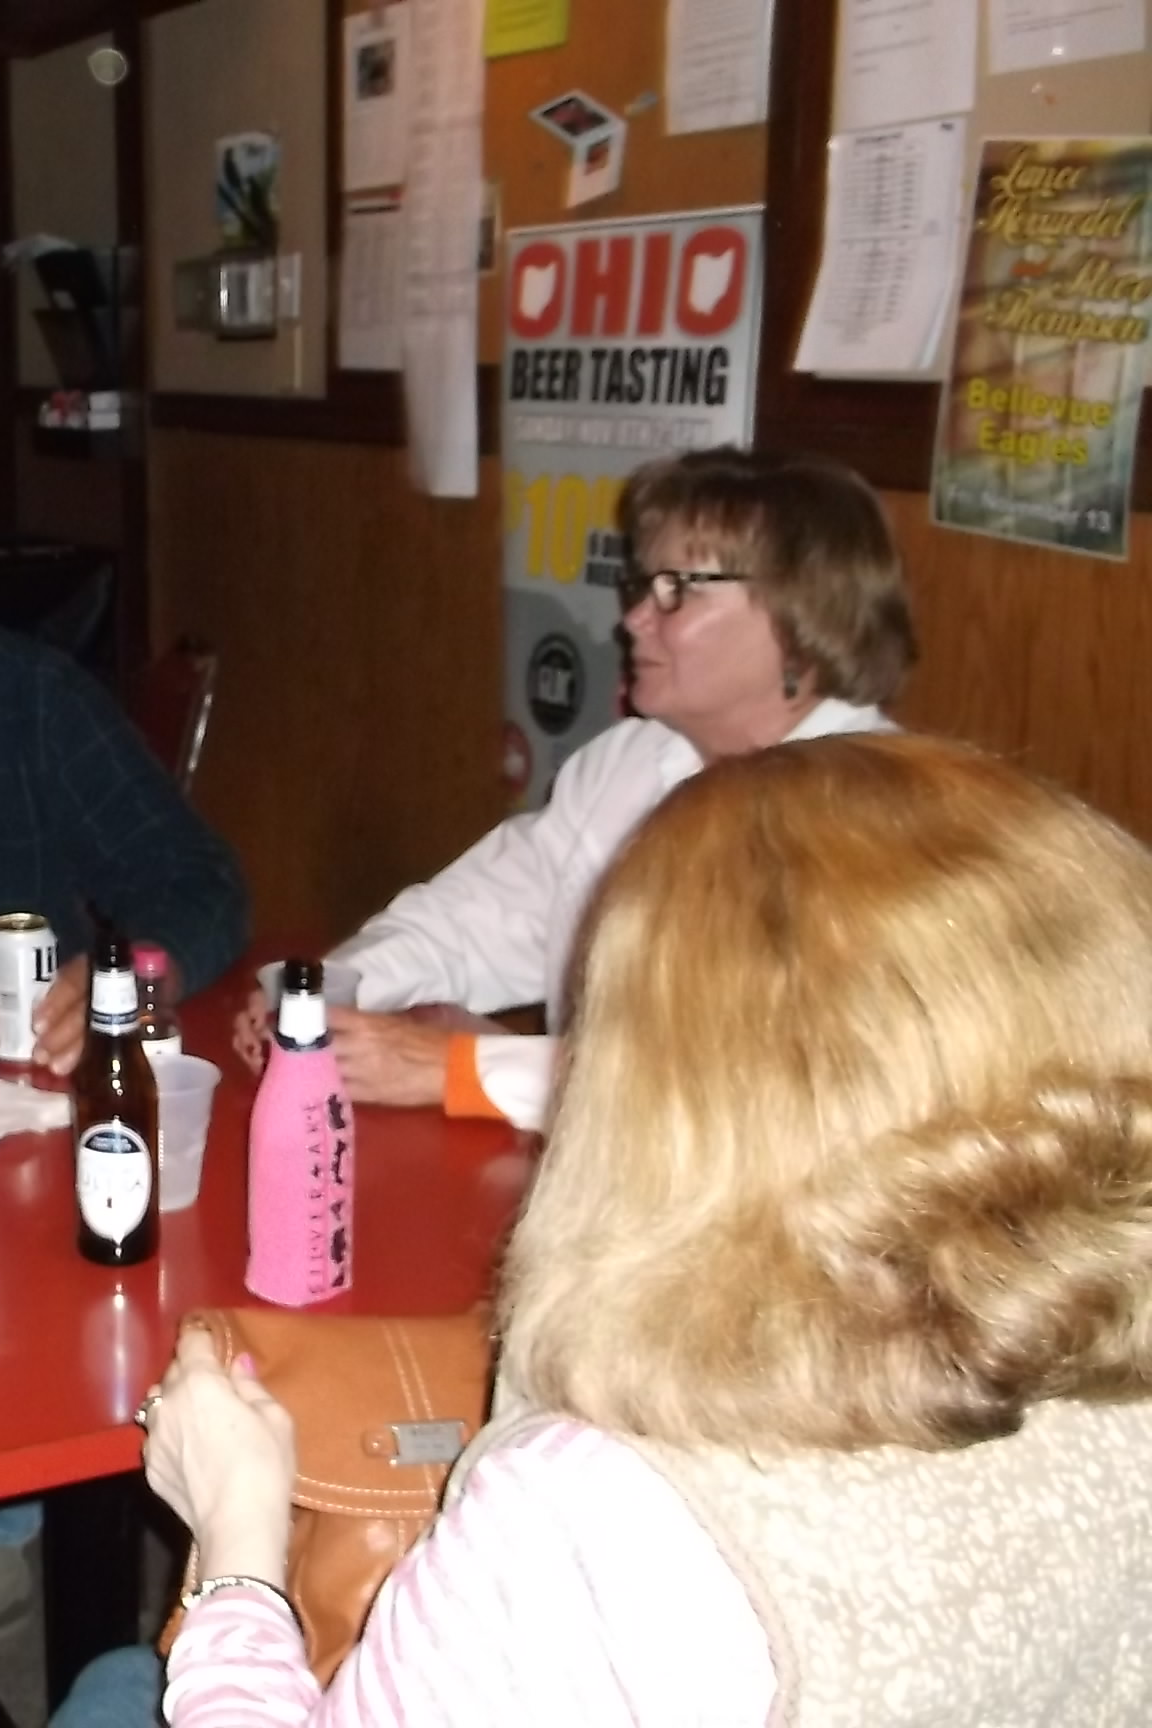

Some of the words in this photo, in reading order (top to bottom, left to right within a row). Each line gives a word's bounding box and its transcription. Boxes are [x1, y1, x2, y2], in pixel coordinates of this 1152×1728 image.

[510, 225, 747, 341] OHIO
[511, 349, 582, 401] BEER
[592, 346, 729, 405] TASTING
[968, 377, 1112, 429] Bellevue
[978, 417, 1090, 466] Eagles
